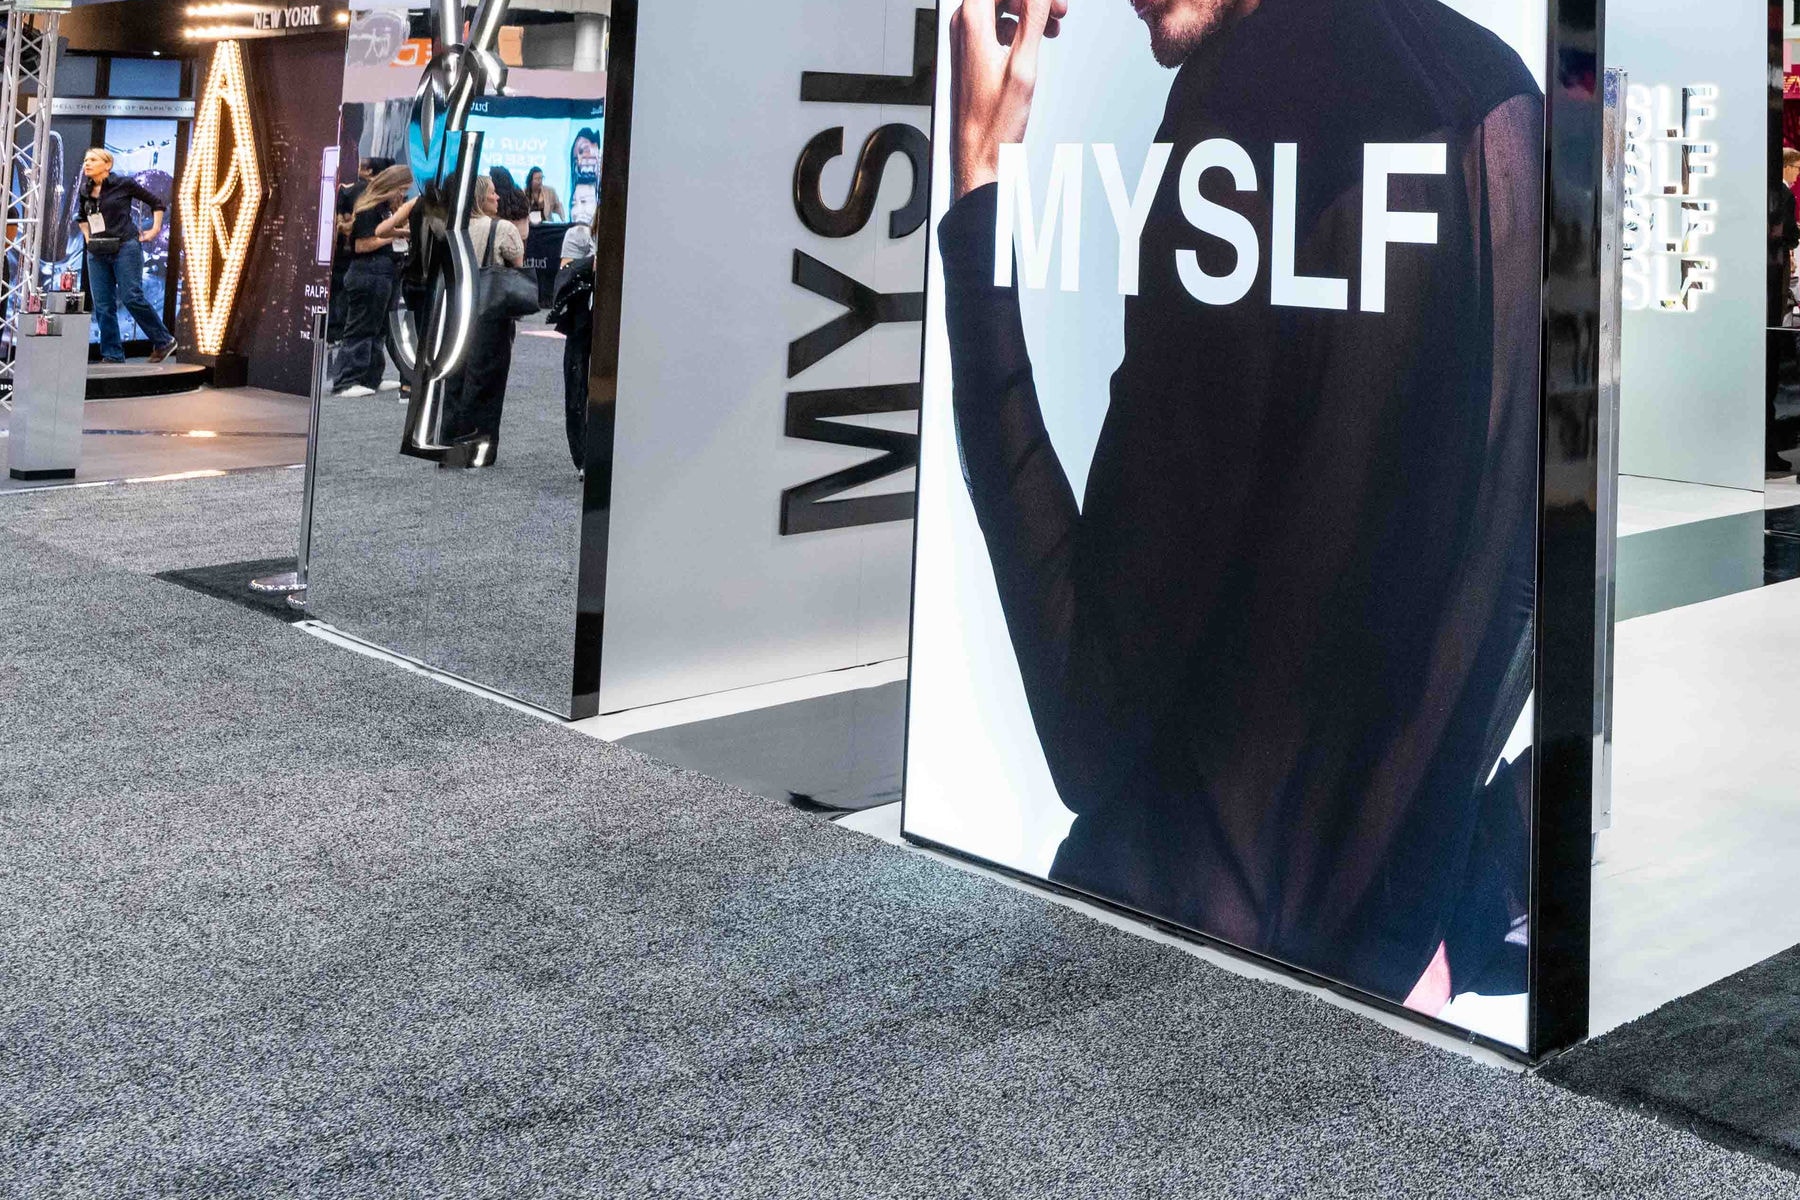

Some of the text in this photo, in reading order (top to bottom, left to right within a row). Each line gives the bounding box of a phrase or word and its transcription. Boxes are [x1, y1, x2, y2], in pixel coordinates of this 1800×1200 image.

[254, 4, 321, 30] NEW YORK
[993, 137, 1447, 313] MYSLF
